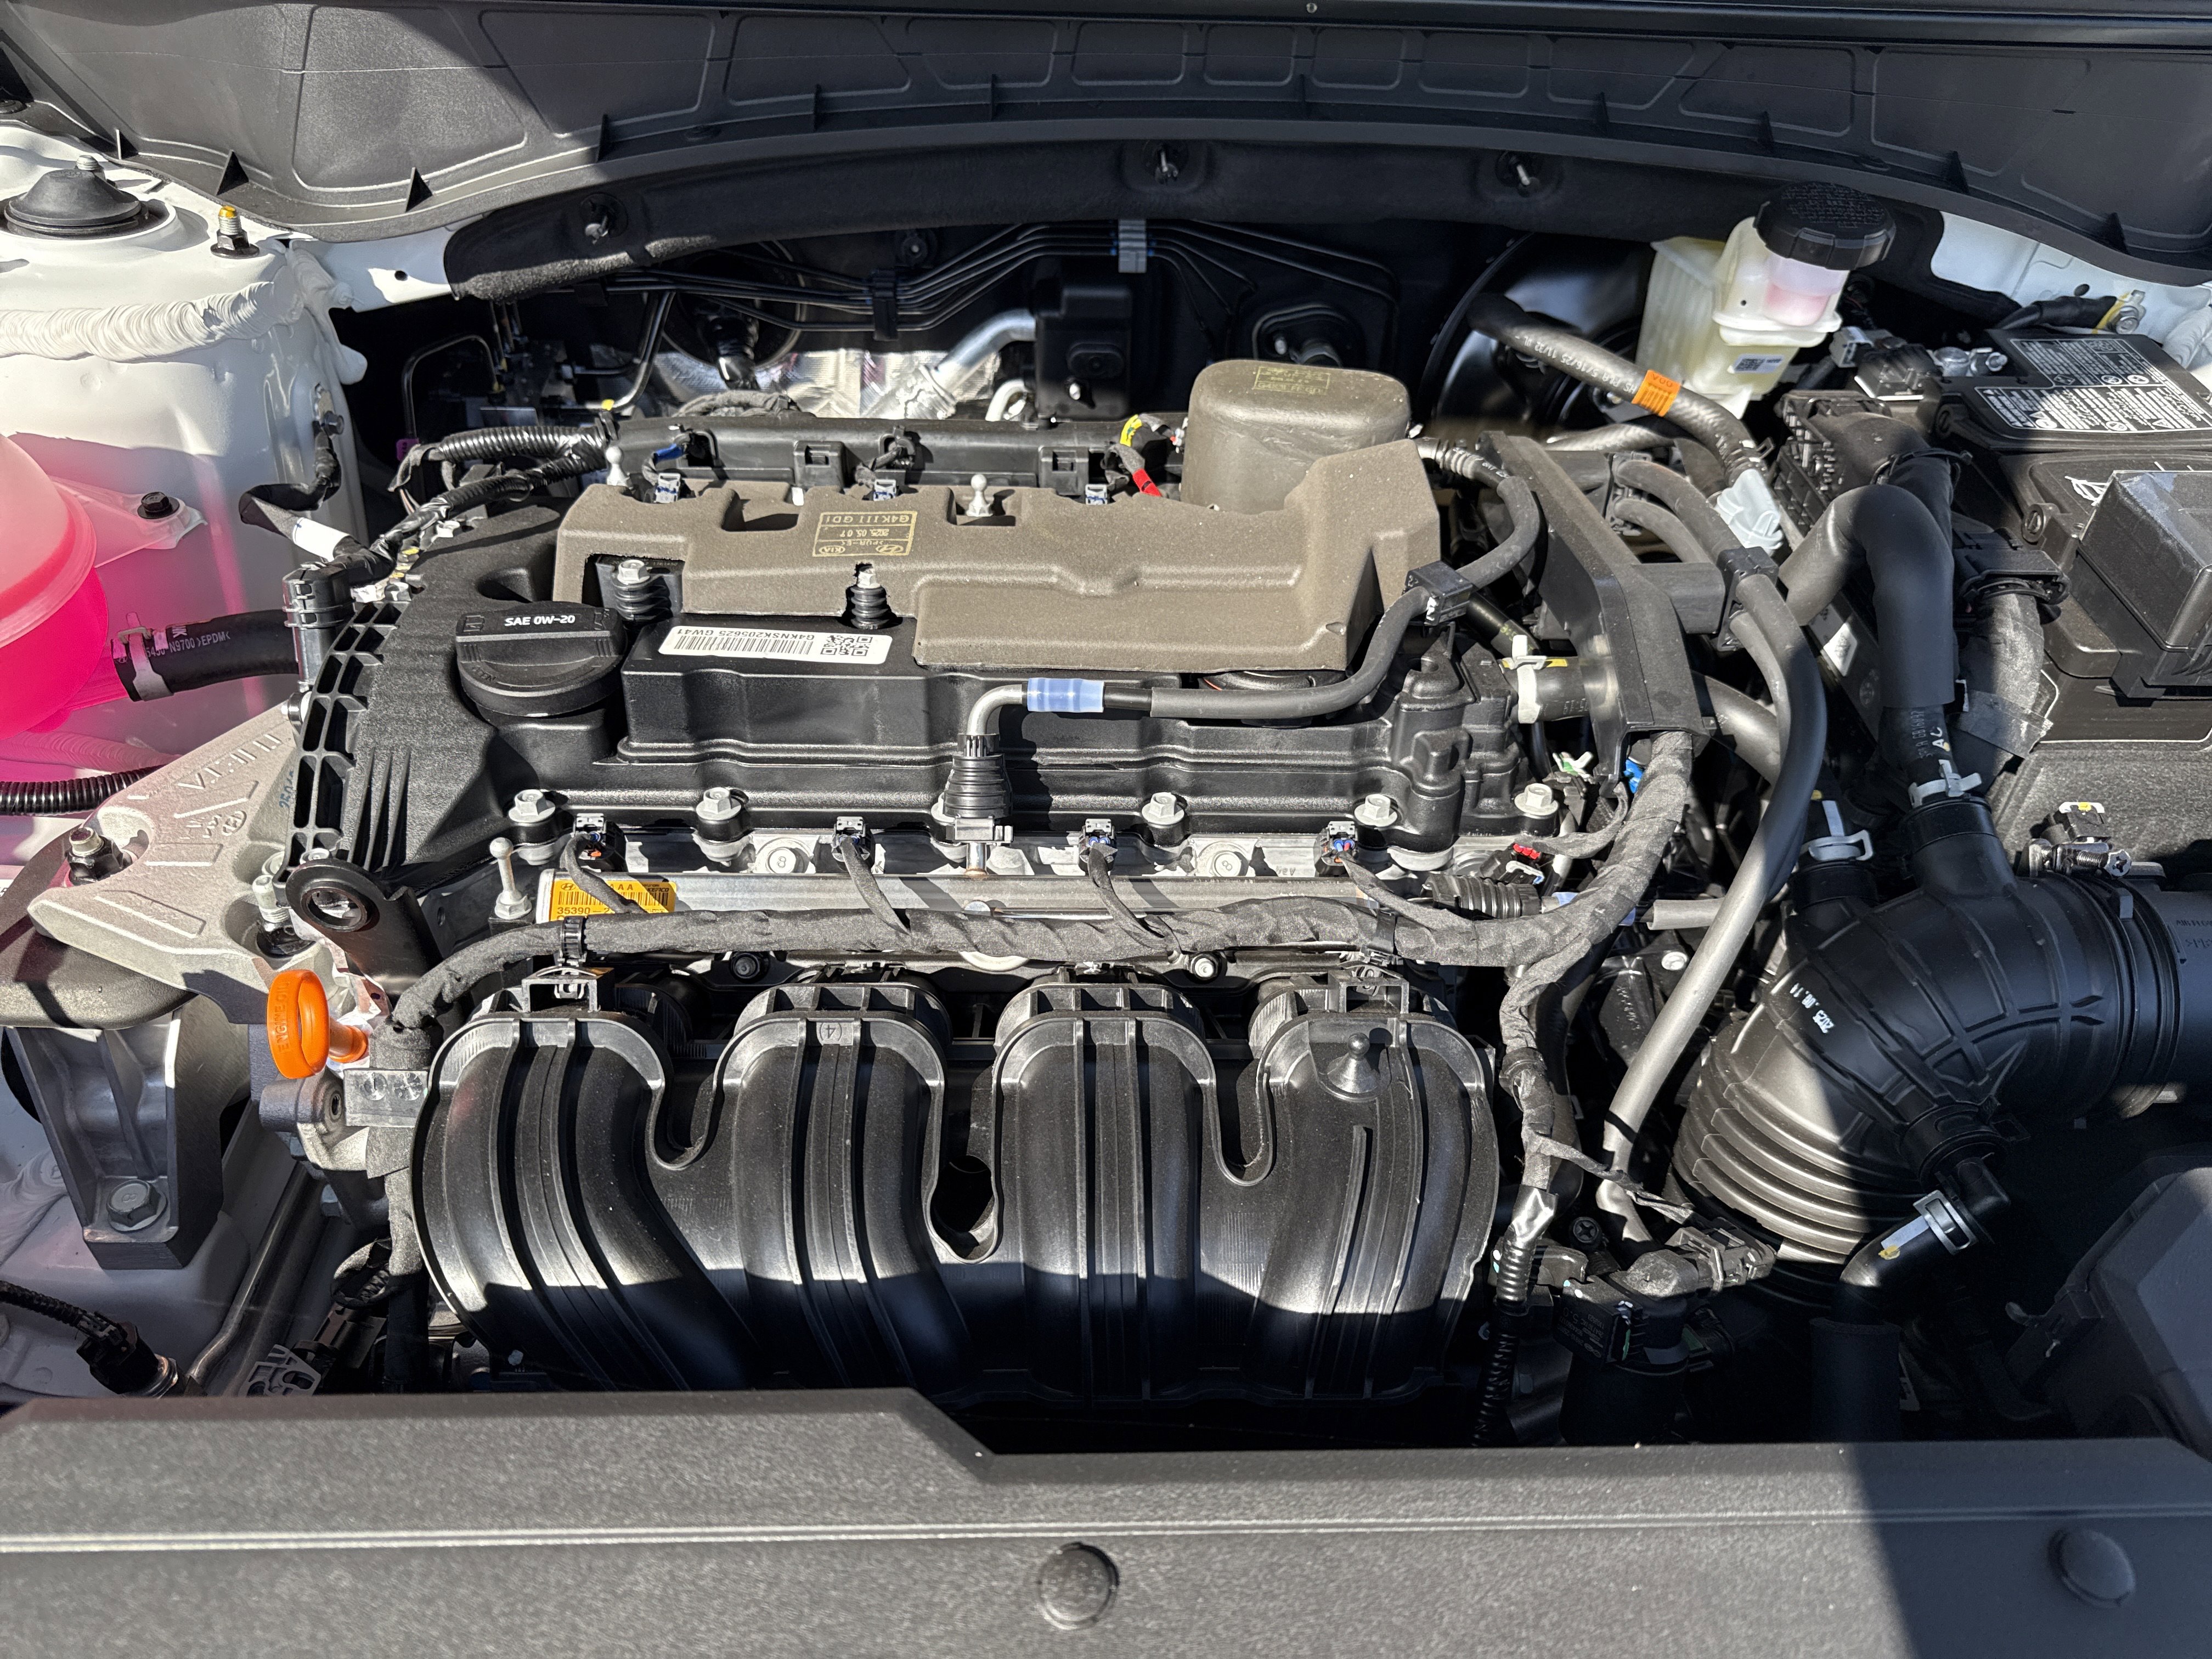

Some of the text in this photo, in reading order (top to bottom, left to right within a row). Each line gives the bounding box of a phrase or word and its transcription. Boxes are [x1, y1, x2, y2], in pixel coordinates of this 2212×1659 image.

[825, 515, 854, 523] GDI
[505, 614, 575, 627] SAE 0W-20
[677, 628, 815, 641] G4KNSK205625 GW41
[274, 1004, 290, 1053] ENGINE
